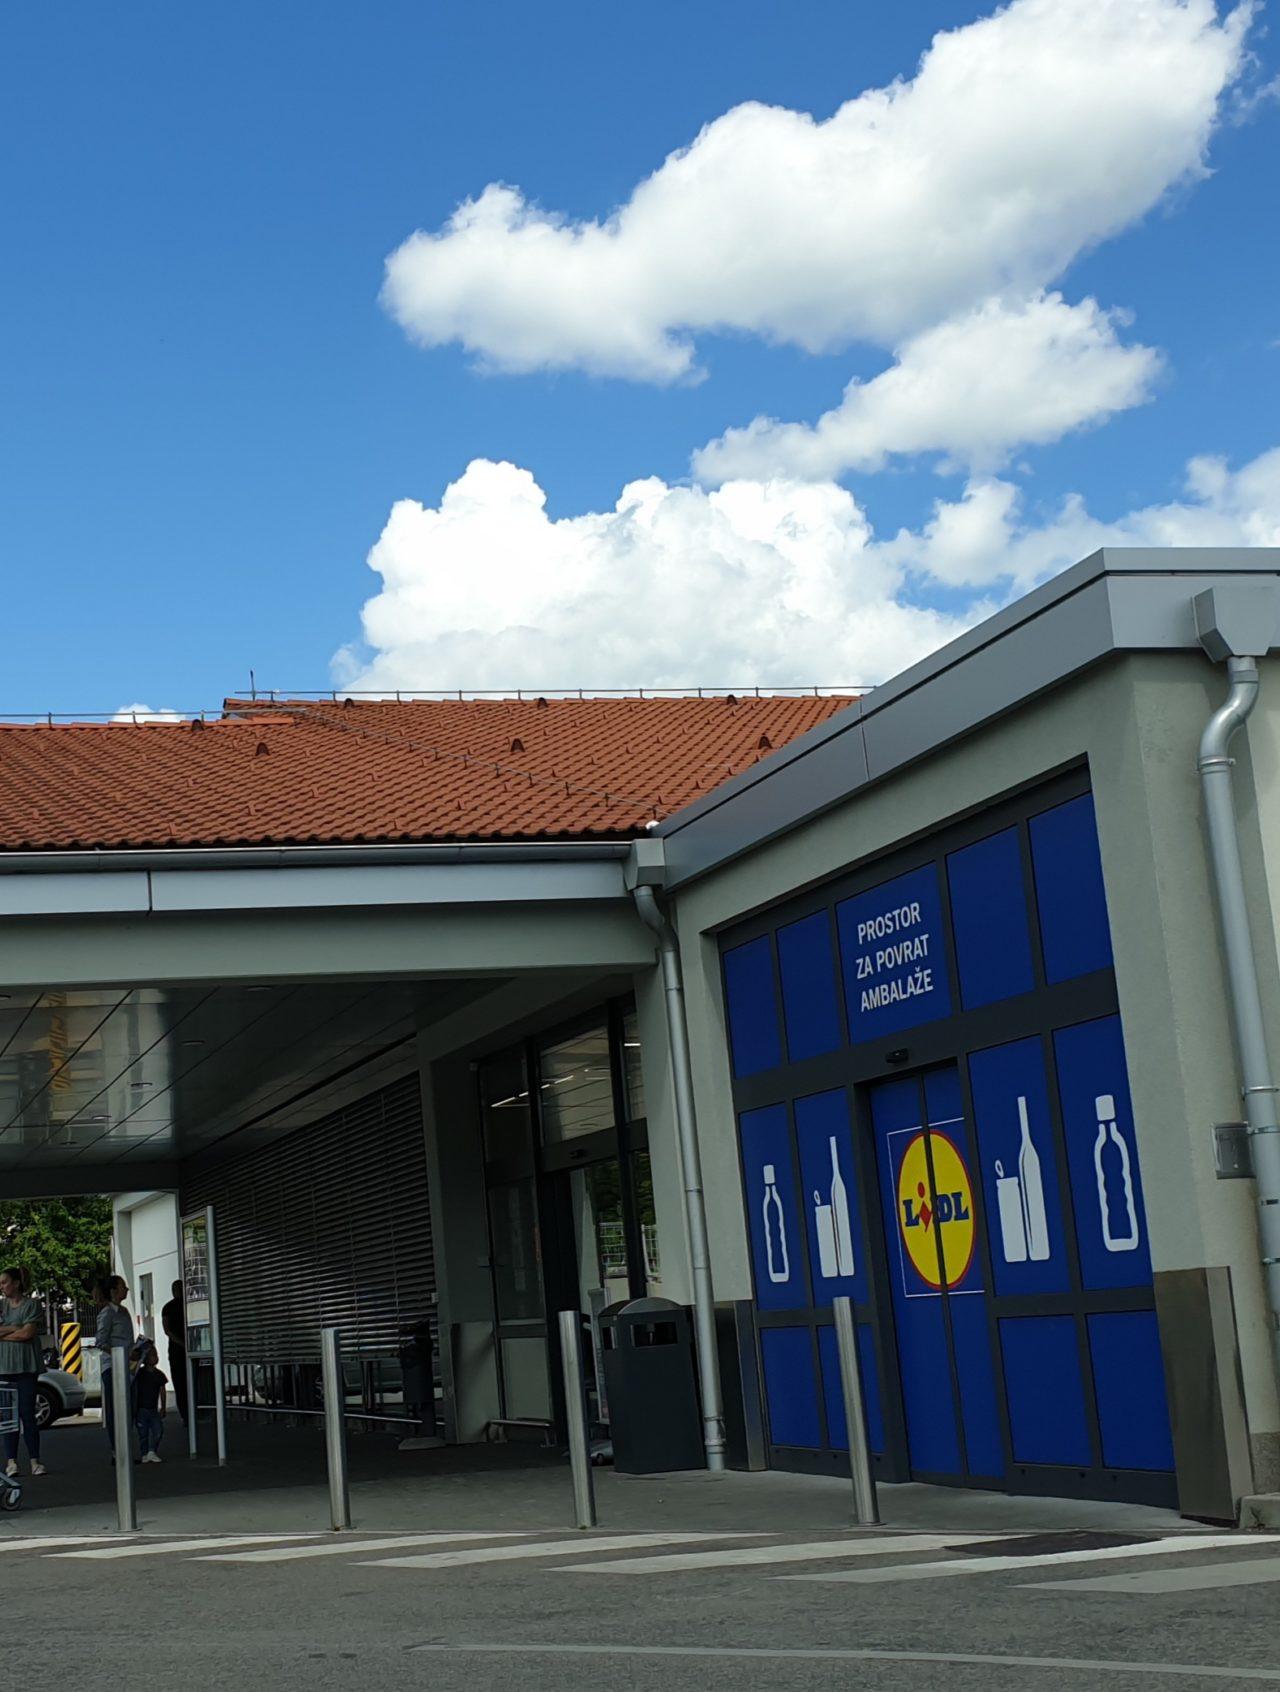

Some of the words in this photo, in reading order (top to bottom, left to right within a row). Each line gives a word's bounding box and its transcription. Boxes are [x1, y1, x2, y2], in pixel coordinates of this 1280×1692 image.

[858, 902, 921, 944] PROSTOR
[856, 955, 874, 979] ZA
[876, 933, 929, 972] POVRAT
[861, 965, 934, 1012] AMBALAŽE
